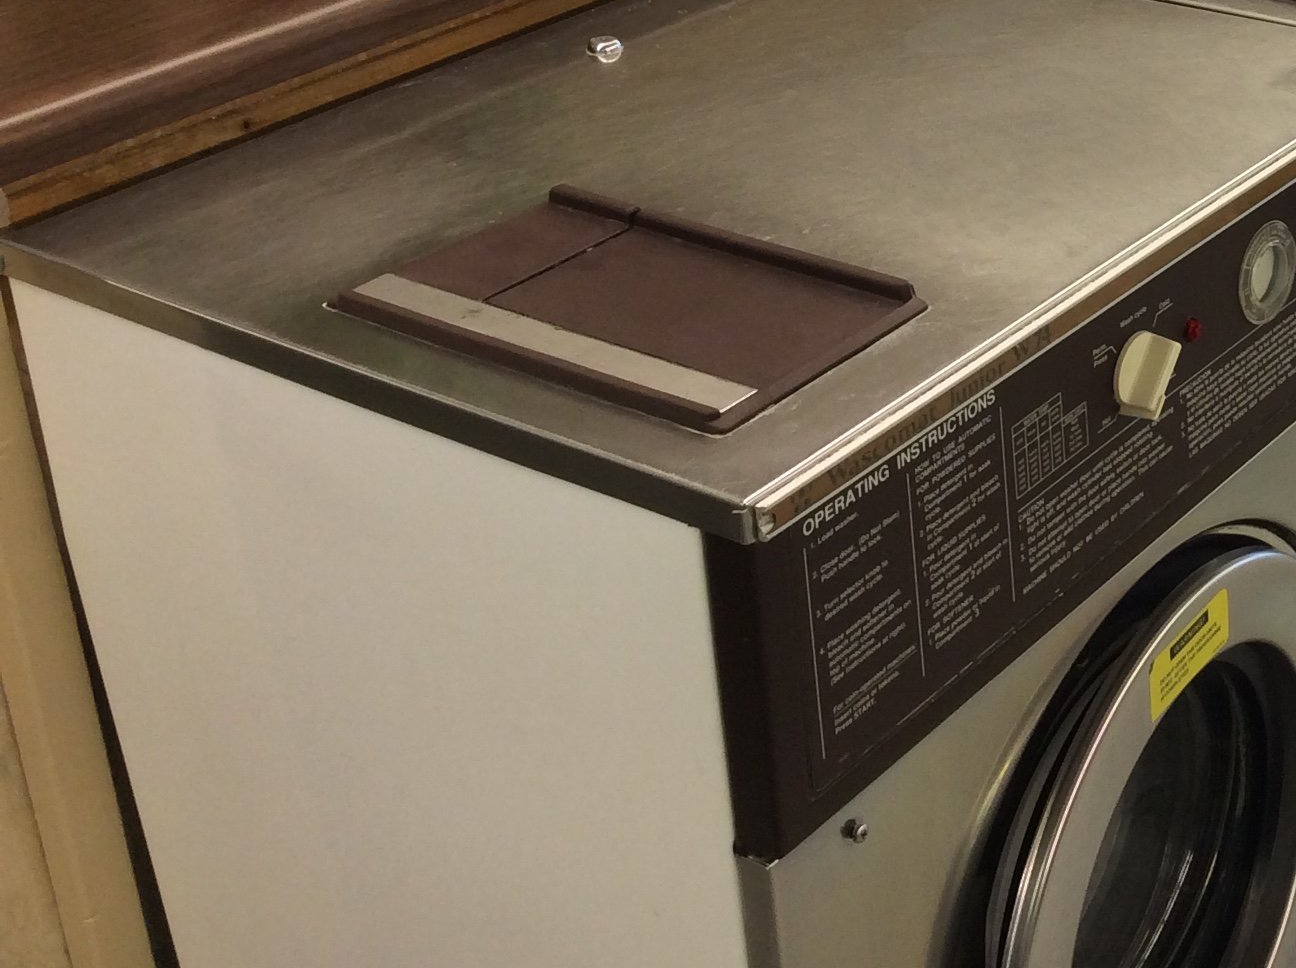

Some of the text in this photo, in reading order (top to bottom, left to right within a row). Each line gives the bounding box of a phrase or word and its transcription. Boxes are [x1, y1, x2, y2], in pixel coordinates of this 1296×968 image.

[829, 406, 937, 486] Wascomat
[949, 360, 1004, 408] Junior
[801, 461, 890, 538] OPERATING
[896, 387, 996, 471] INSTRUCTIONS
[817, 527, 833, 545] Load
[1017, 496, 1045, 524] CAUTION
